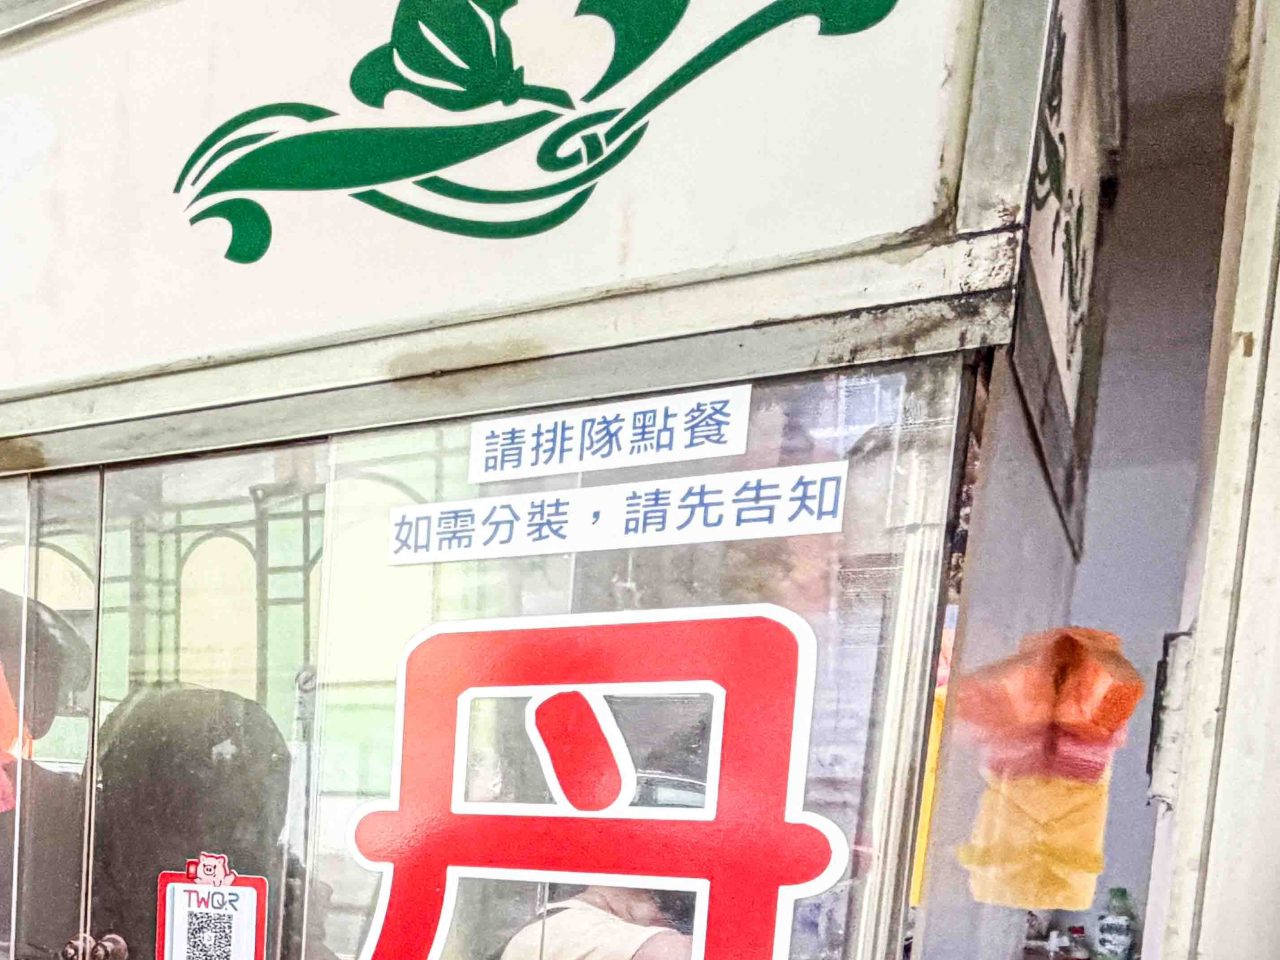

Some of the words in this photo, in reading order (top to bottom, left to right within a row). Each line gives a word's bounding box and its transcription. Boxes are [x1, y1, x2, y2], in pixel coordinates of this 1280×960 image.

[484, 398, 730, 474] 請排隊點餐
[394, 475, 840, 557] 如需分裝，請先告知
[183, 889, 240, 911] TWQR
